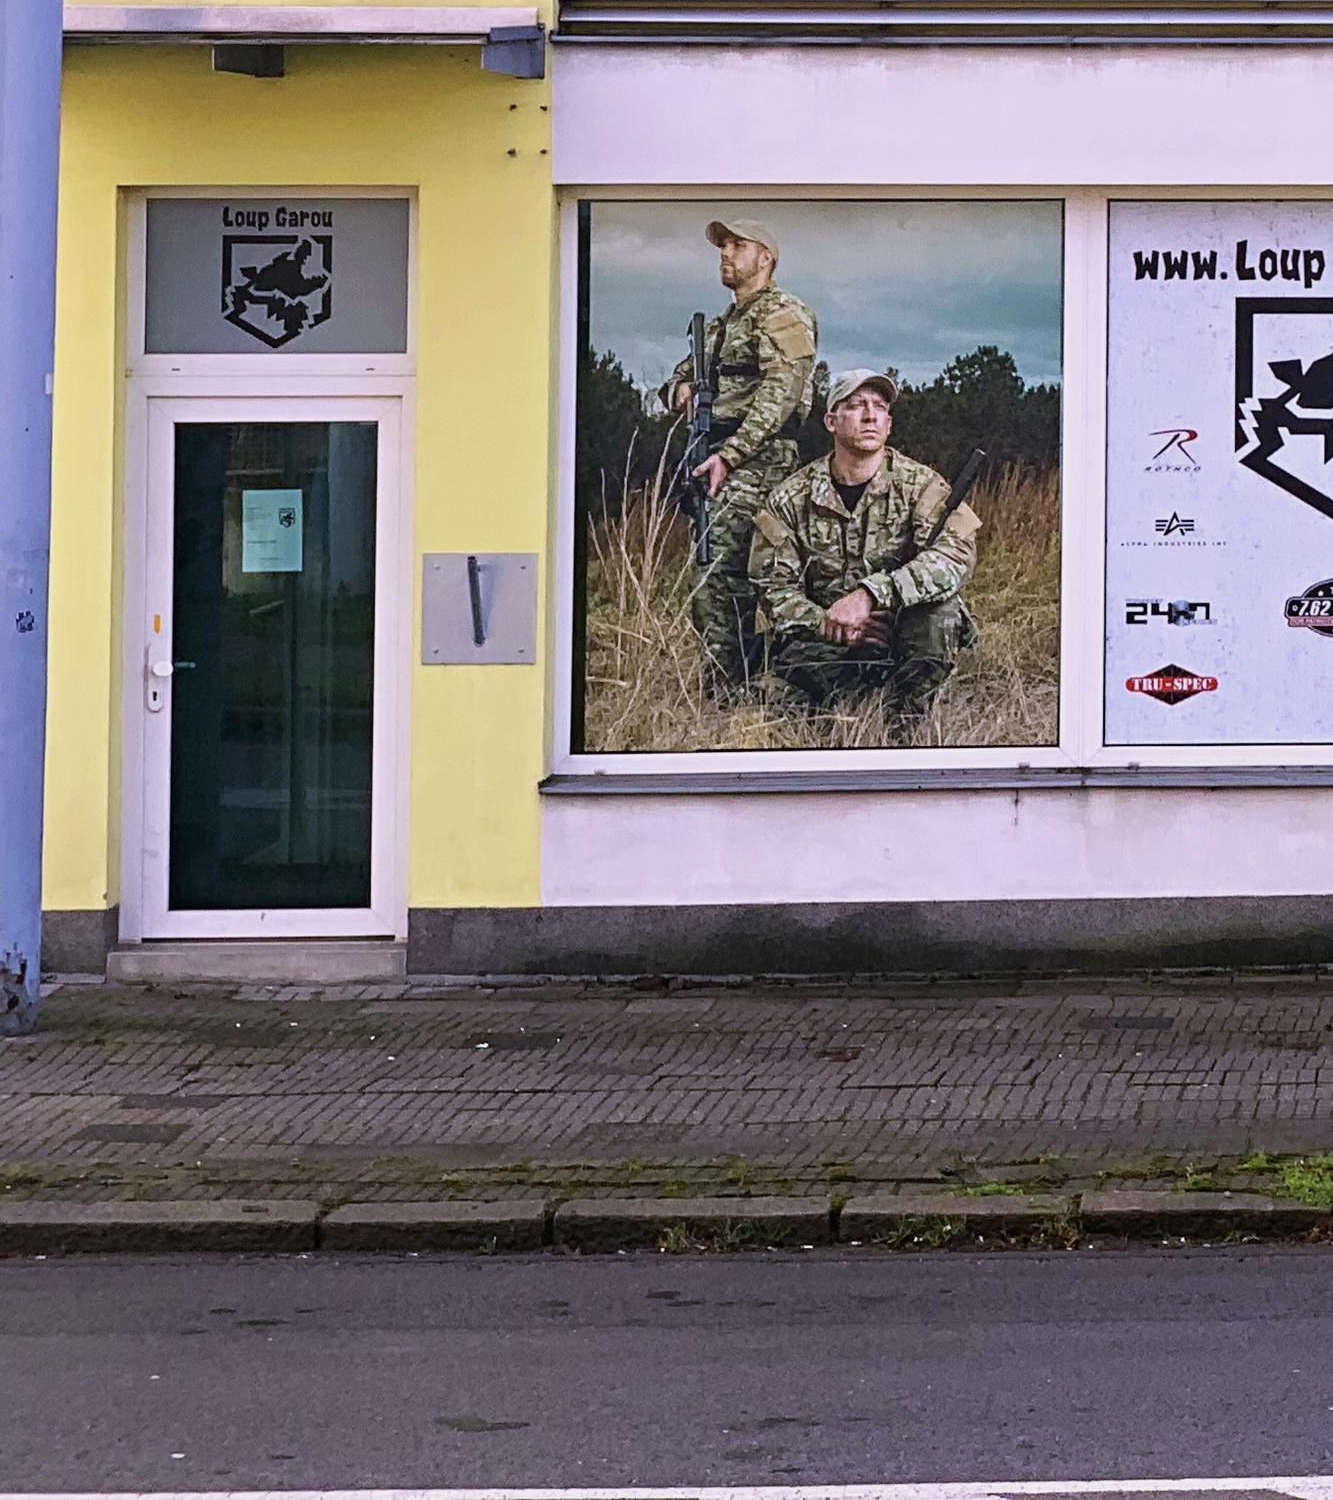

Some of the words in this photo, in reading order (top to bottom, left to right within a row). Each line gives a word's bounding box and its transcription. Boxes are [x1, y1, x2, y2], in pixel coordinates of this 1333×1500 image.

[222, 206, 270, 231] Loup
[275, 207, 333, 228] Garou
[1298, 600, 1332, 616] 7.62
[1131, 678, 1213, 692] TRU-SPEC
